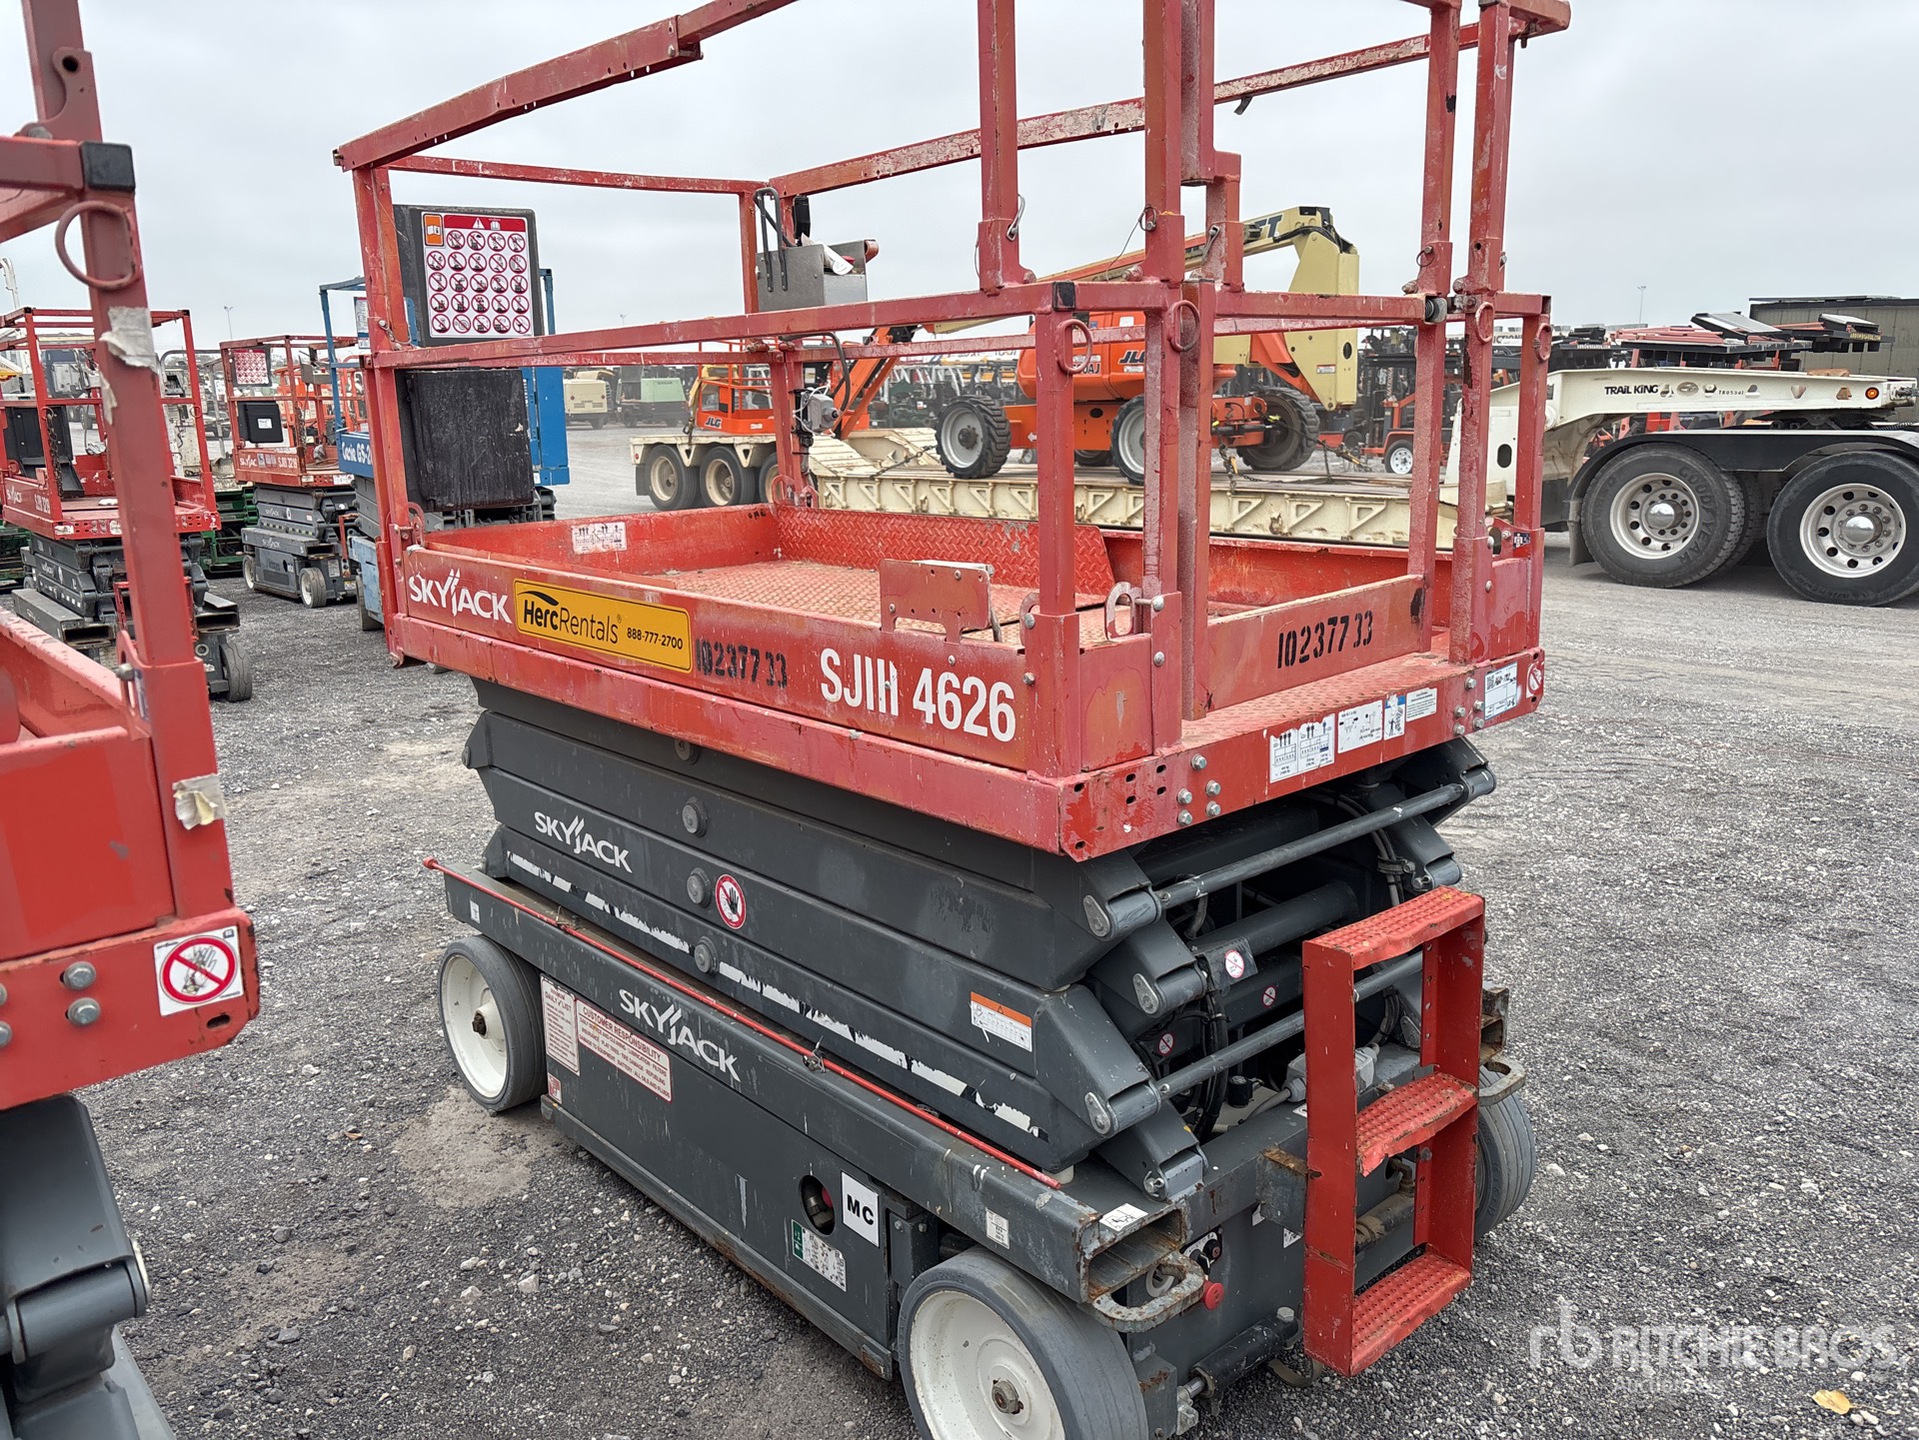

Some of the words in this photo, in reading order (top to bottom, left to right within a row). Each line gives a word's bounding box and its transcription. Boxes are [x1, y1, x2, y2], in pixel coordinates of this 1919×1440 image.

[705, 417, 721, 428] JLG
[408, 568, 513, 624] SKYJACK
[626, 626, 684, 650] 888-777-2700
[913, 667, 1016, 743] 4626
[534, 811, 633, 874] SKYJACK
[583, 1005, 612, 1032] CUSTOMER
[614, 1024, 661, 1064] RESPONSIBILITY
[618, 988, 741, 1083] SKYJACK
[847, 1194, 874, 1226] MC
